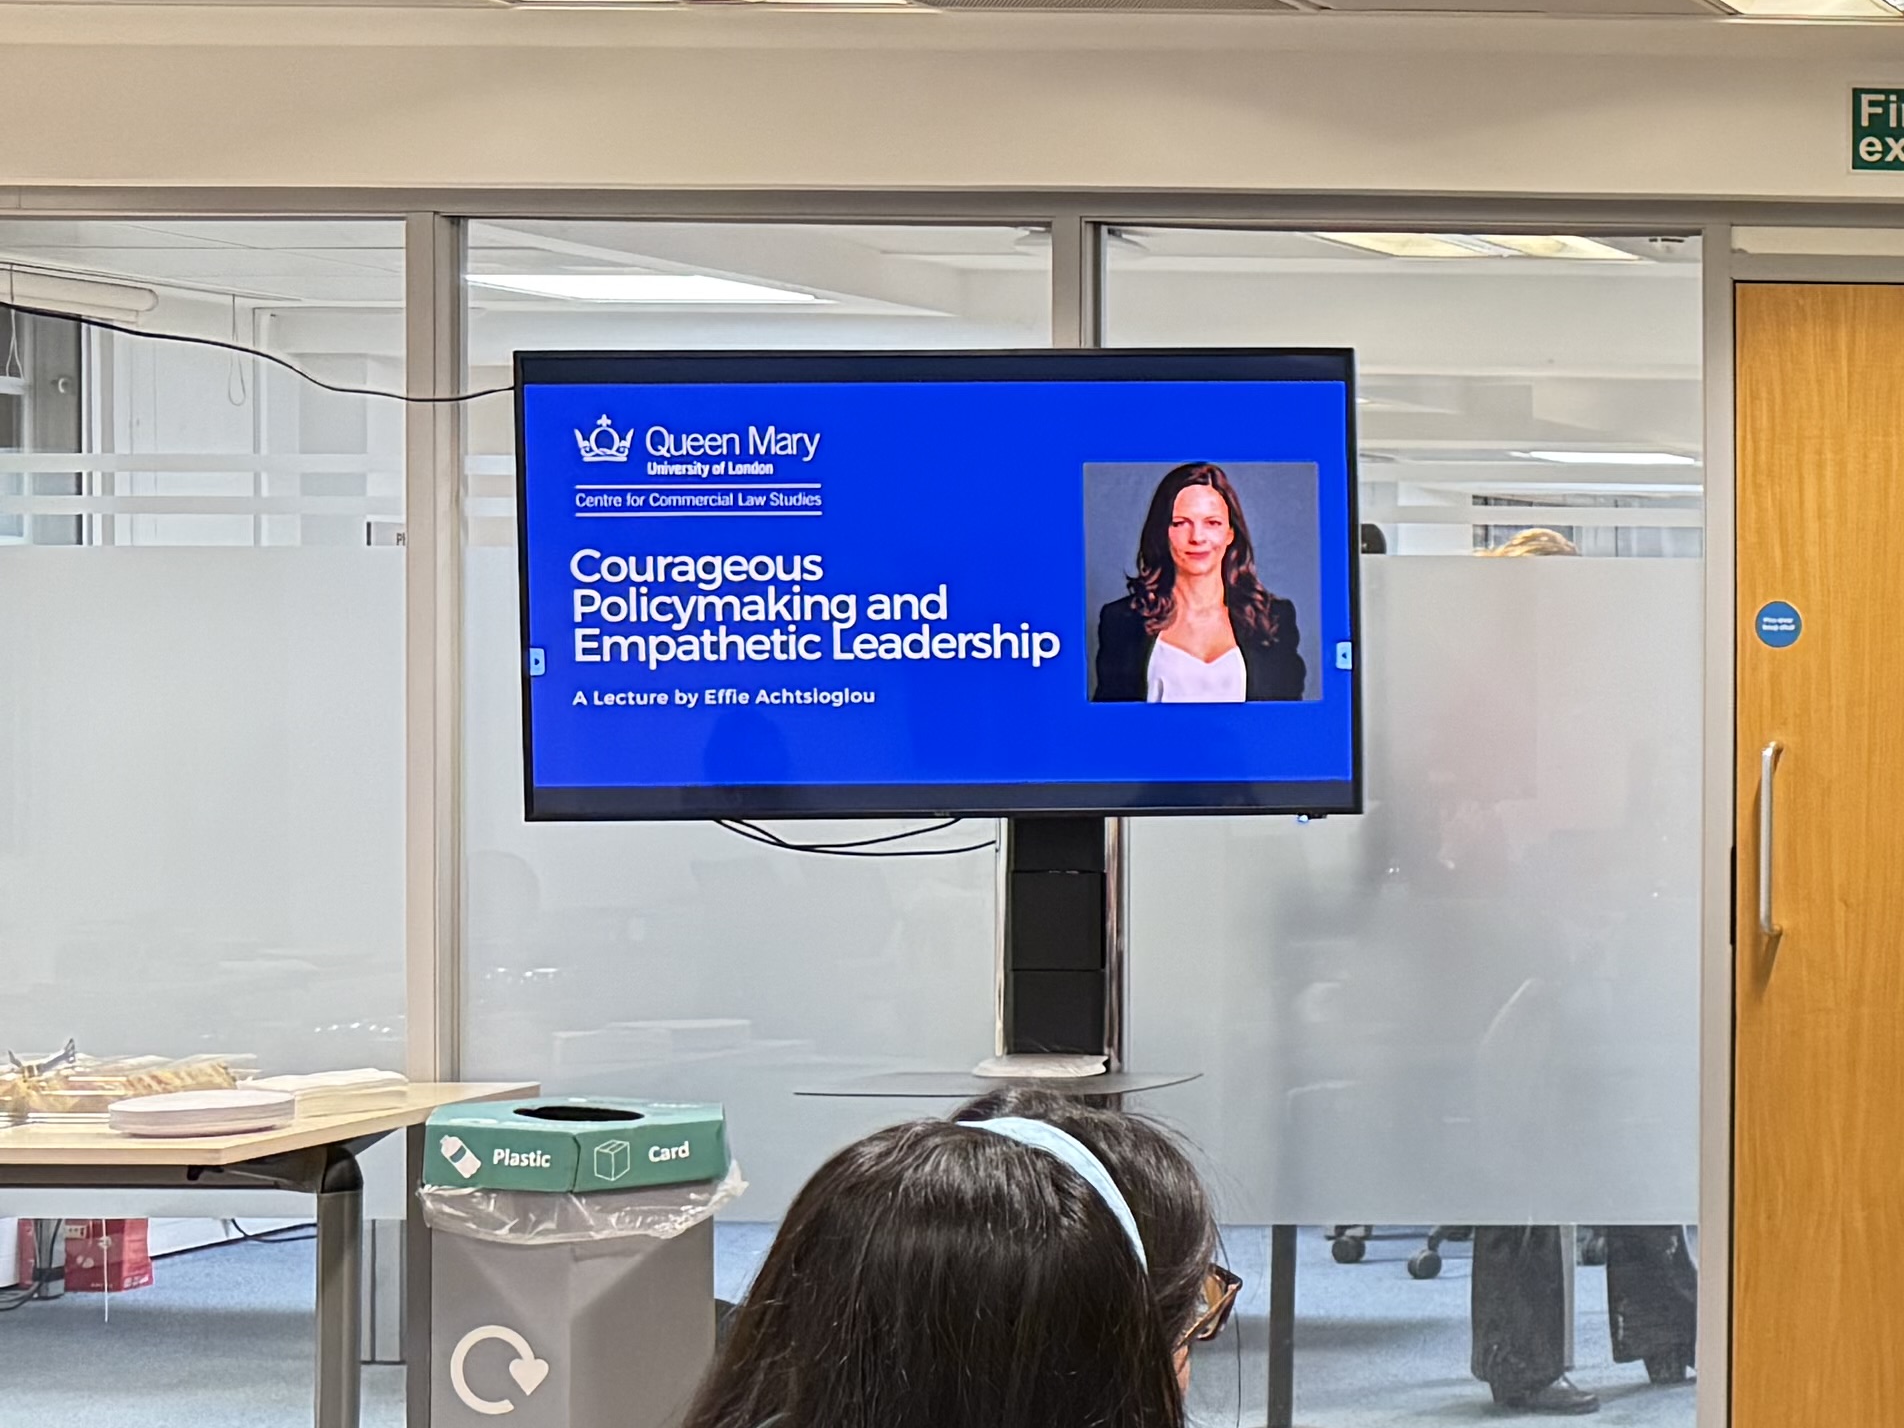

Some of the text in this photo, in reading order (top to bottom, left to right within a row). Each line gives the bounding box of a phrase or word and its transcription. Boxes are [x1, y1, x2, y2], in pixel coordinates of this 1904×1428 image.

[646, 425, 821, 462] Queen Mary
[647, 461, 774, 478] University of London
[575, 491, 822, 507] Centre for Commercial Law Studies
[569, 548, 824, 590] Courageous
[573, 583, 948, 630] Policymaking and
[574, 621, 1061, 670] Empathetic Leadership
[572, 687, 875, 709] A Lecture by Effie Achtsioglou
[492, 1148, 551, 1168] Plastic
[648, 1140, 690, 1163] Card
